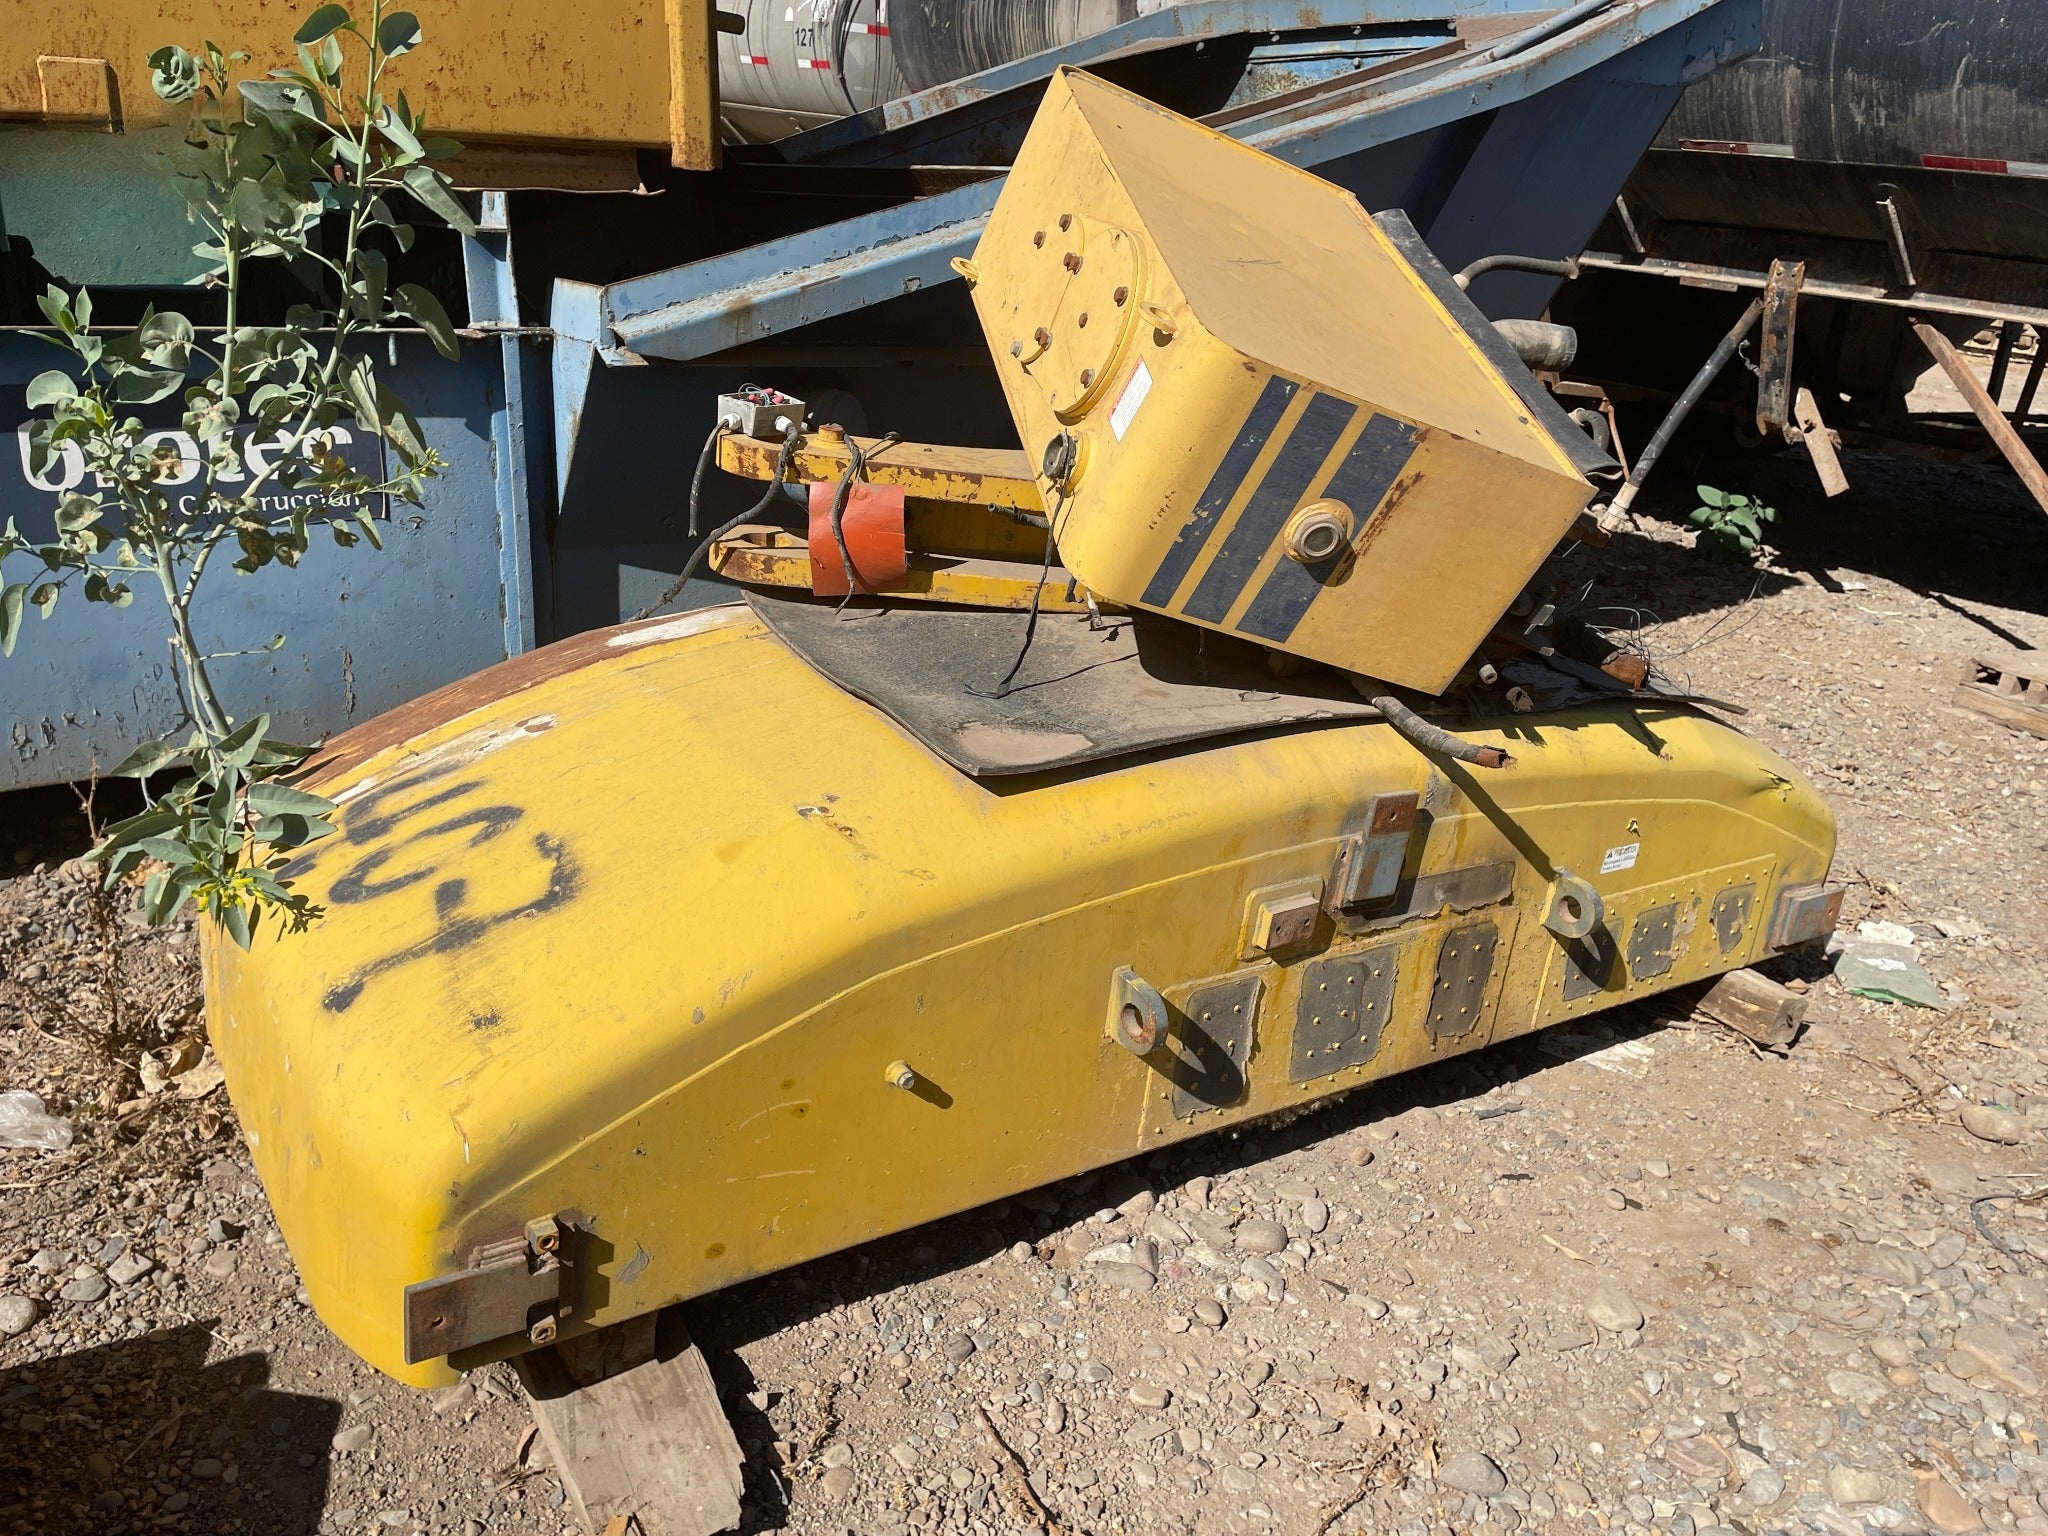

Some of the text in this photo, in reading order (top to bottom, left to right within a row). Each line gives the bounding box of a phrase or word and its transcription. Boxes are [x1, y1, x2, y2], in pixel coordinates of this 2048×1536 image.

[795, 27, 814, 47] 127
[17, 418, 357, 492] botec
[179, 488, 360, 516] Cruccin
